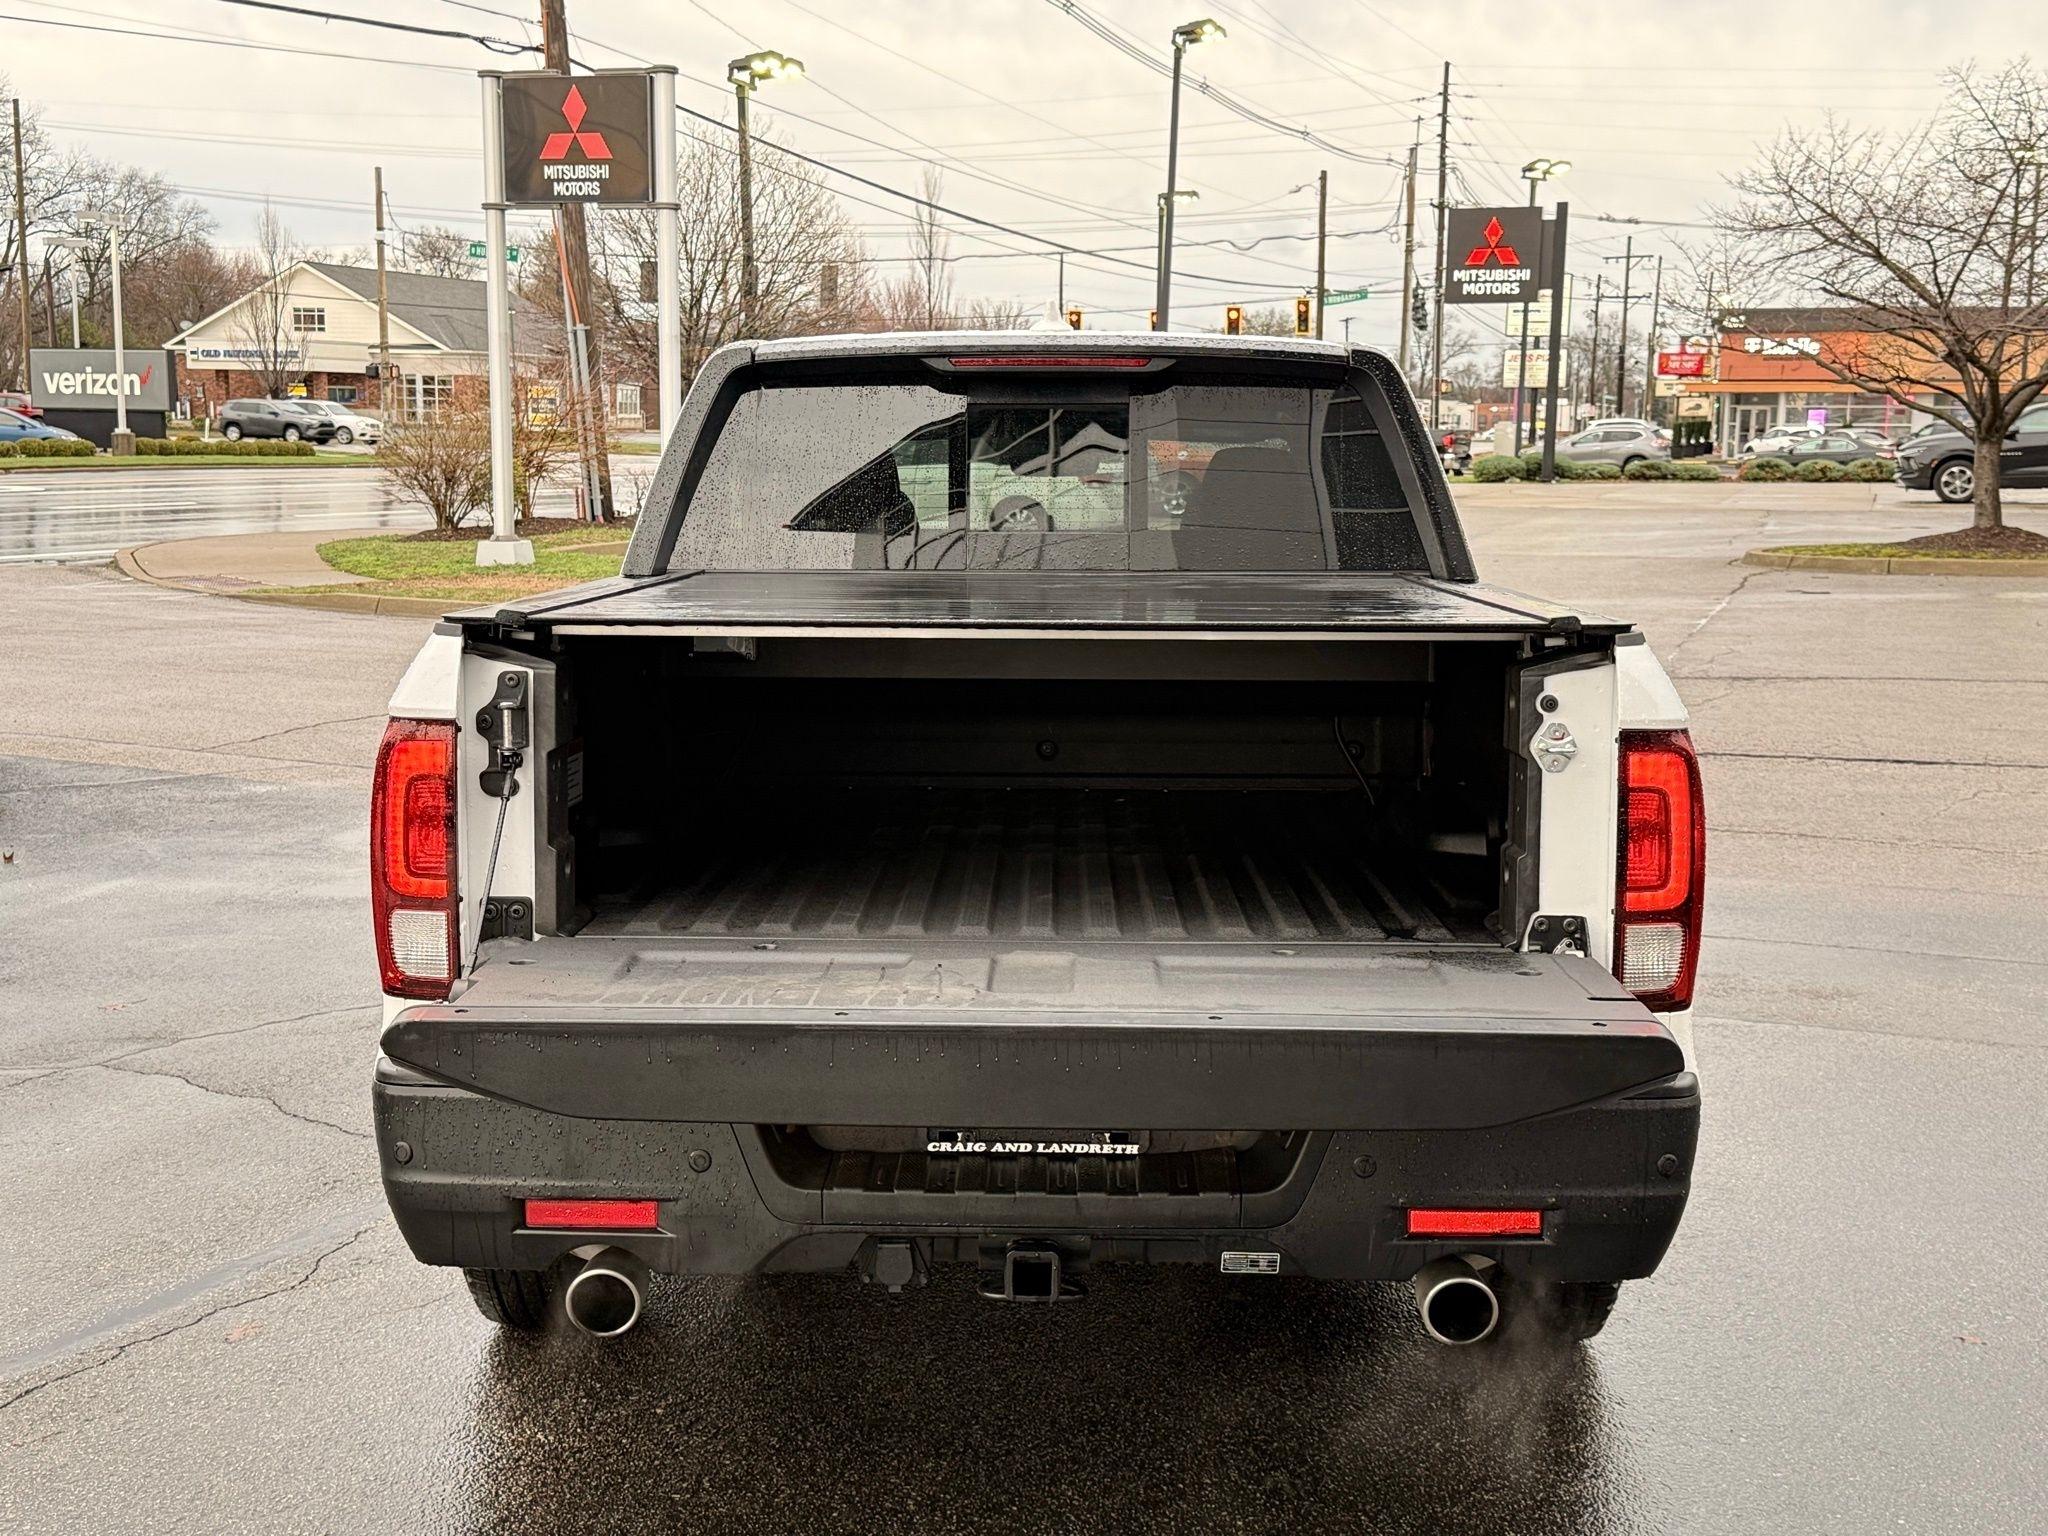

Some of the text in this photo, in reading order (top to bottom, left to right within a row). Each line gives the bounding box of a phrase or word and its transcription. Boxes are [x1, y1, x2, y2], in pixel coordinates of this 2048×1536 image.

[543, 164, 609, 179] MITSUBISHI
[553, 181, 600, 196] MOTORS
[1453, 269, 1531, 282] MITSUBISHI
[1462, 282, 1520, 295] MOTORS
[42, 366, 141, 396] verizon
[927, 1141, 1140, 1155] CRAIG AND LANDRETH
